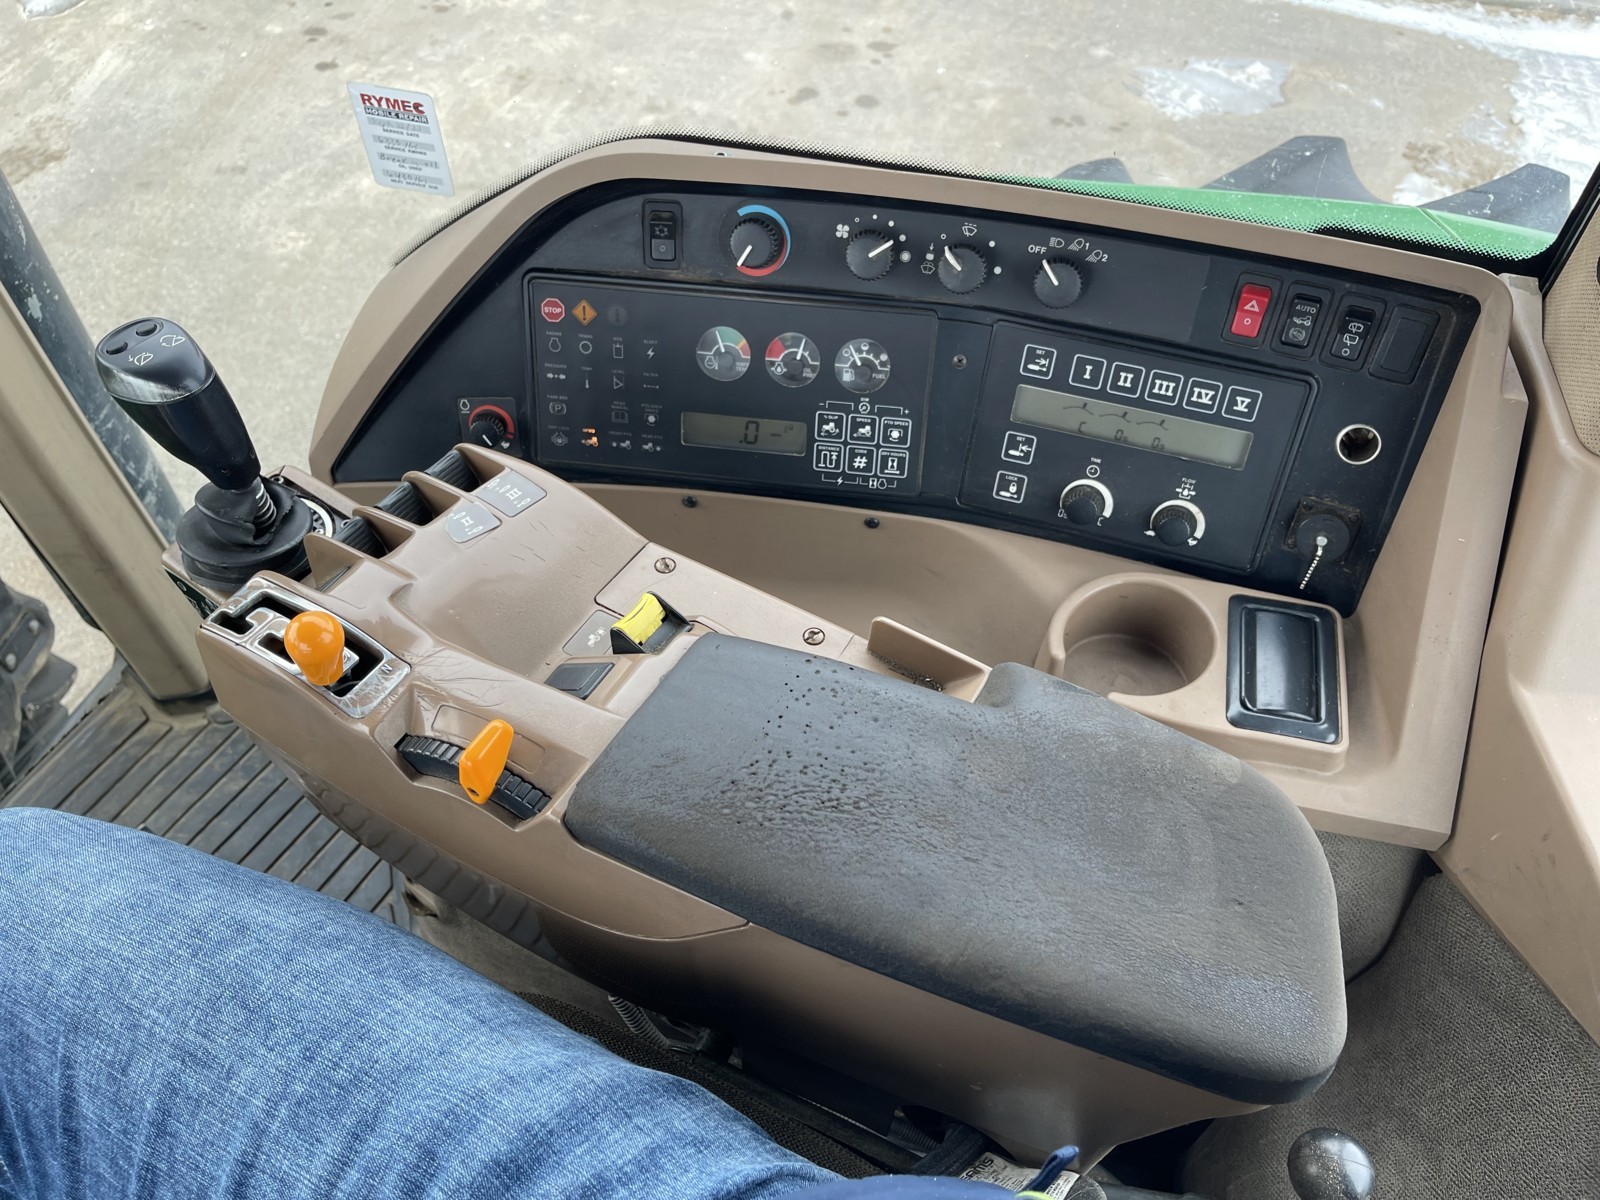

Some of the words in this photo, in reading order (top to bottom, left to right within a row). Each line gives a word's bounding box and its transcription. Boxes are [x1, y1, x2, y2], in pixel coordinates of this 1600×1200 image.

[360, 93, 425, 115] RYMEC
[365, 107, 397, 118] MOBILE
[399, 112, 428, 124] REPAIR
[1028, 244, 1047, 255] OFF
[1084, 242, 1090, 250] 1
[1101, 254, 1108, 262] 2
[1296, 304, 1317, 314] AUTO
[1117, 372, 1134, 388] II
[1152, 380, 1176, 397] III
[1190, 388, 1215, 405] IV
[1233, 396, 1252, 412] V
[380, 663, 393, 674] N
